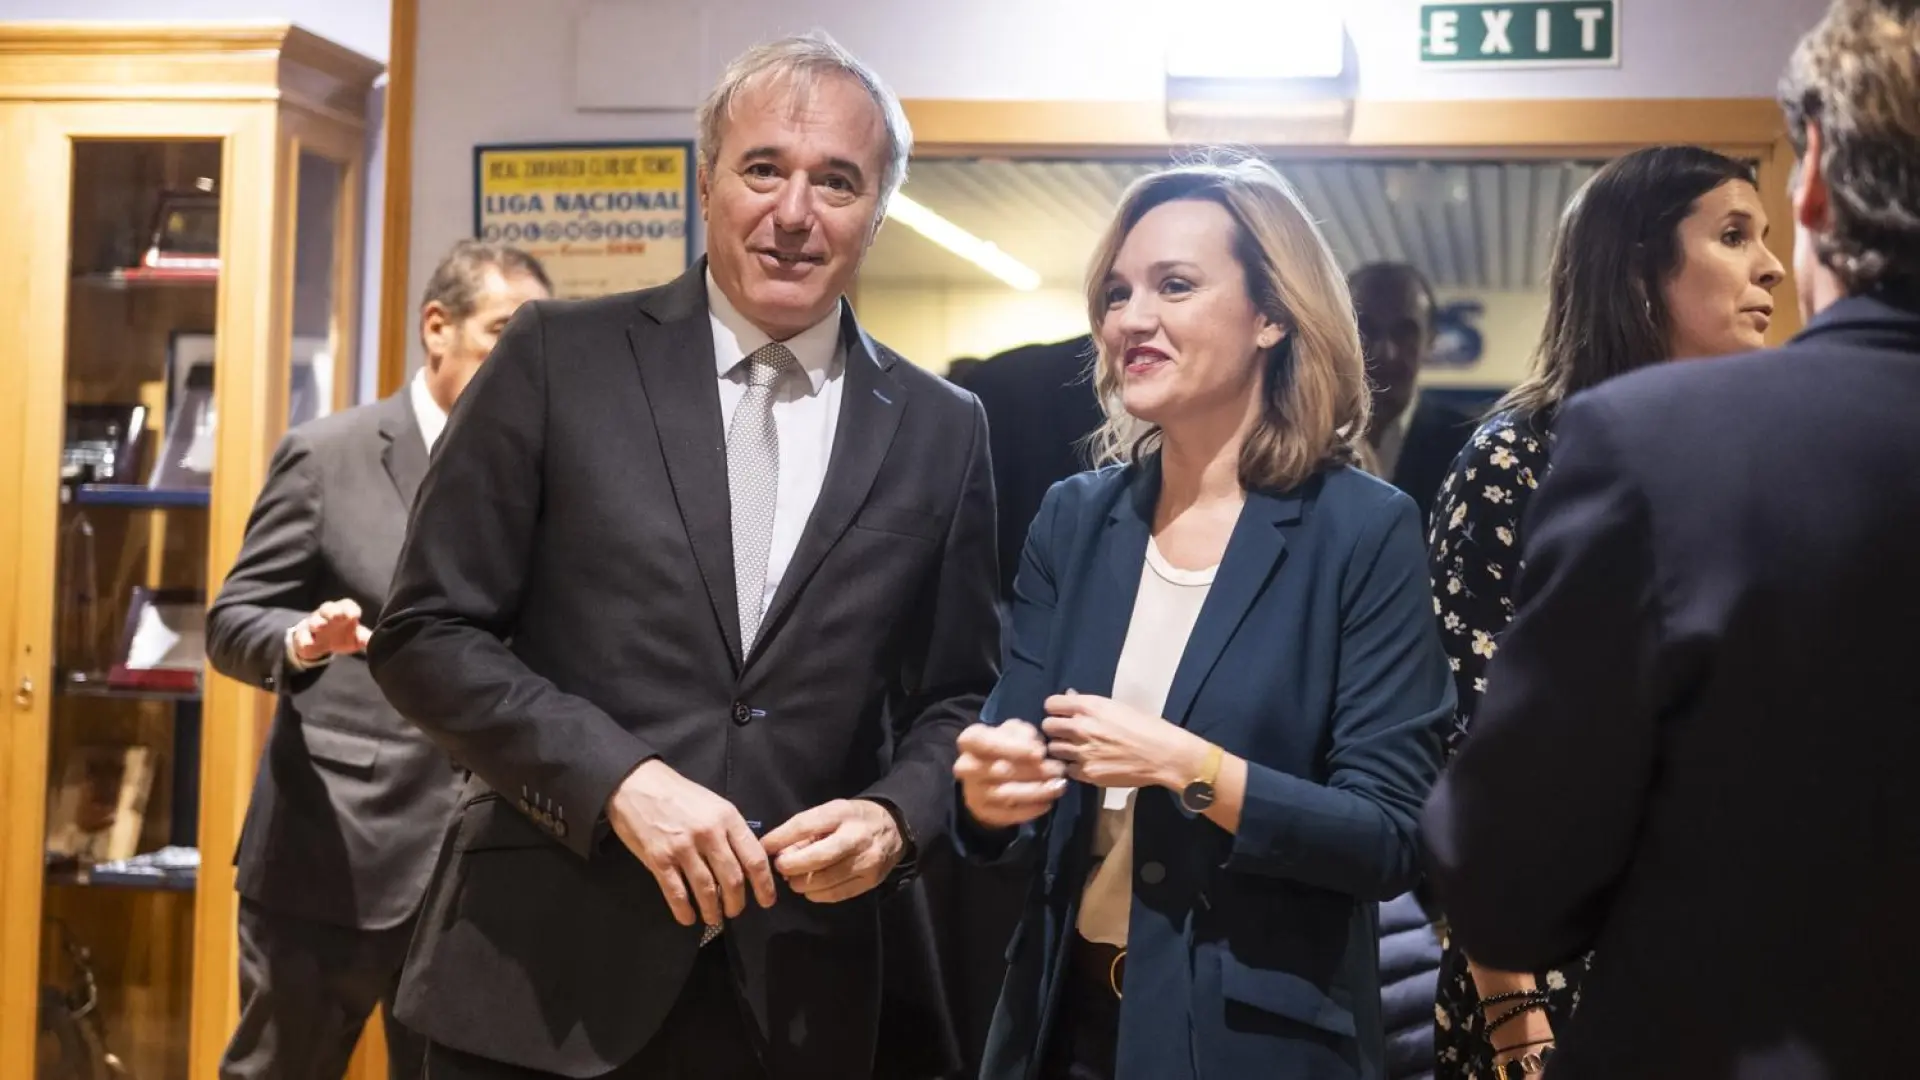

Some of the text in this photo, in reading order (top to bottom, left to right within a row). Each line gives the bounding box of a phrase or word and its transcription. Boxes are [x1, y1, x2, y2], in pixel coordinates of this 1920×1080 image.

[1428, 8, 1604, 55] EXIT
[485, 190, 682, 214] LIGA NACIONAL
